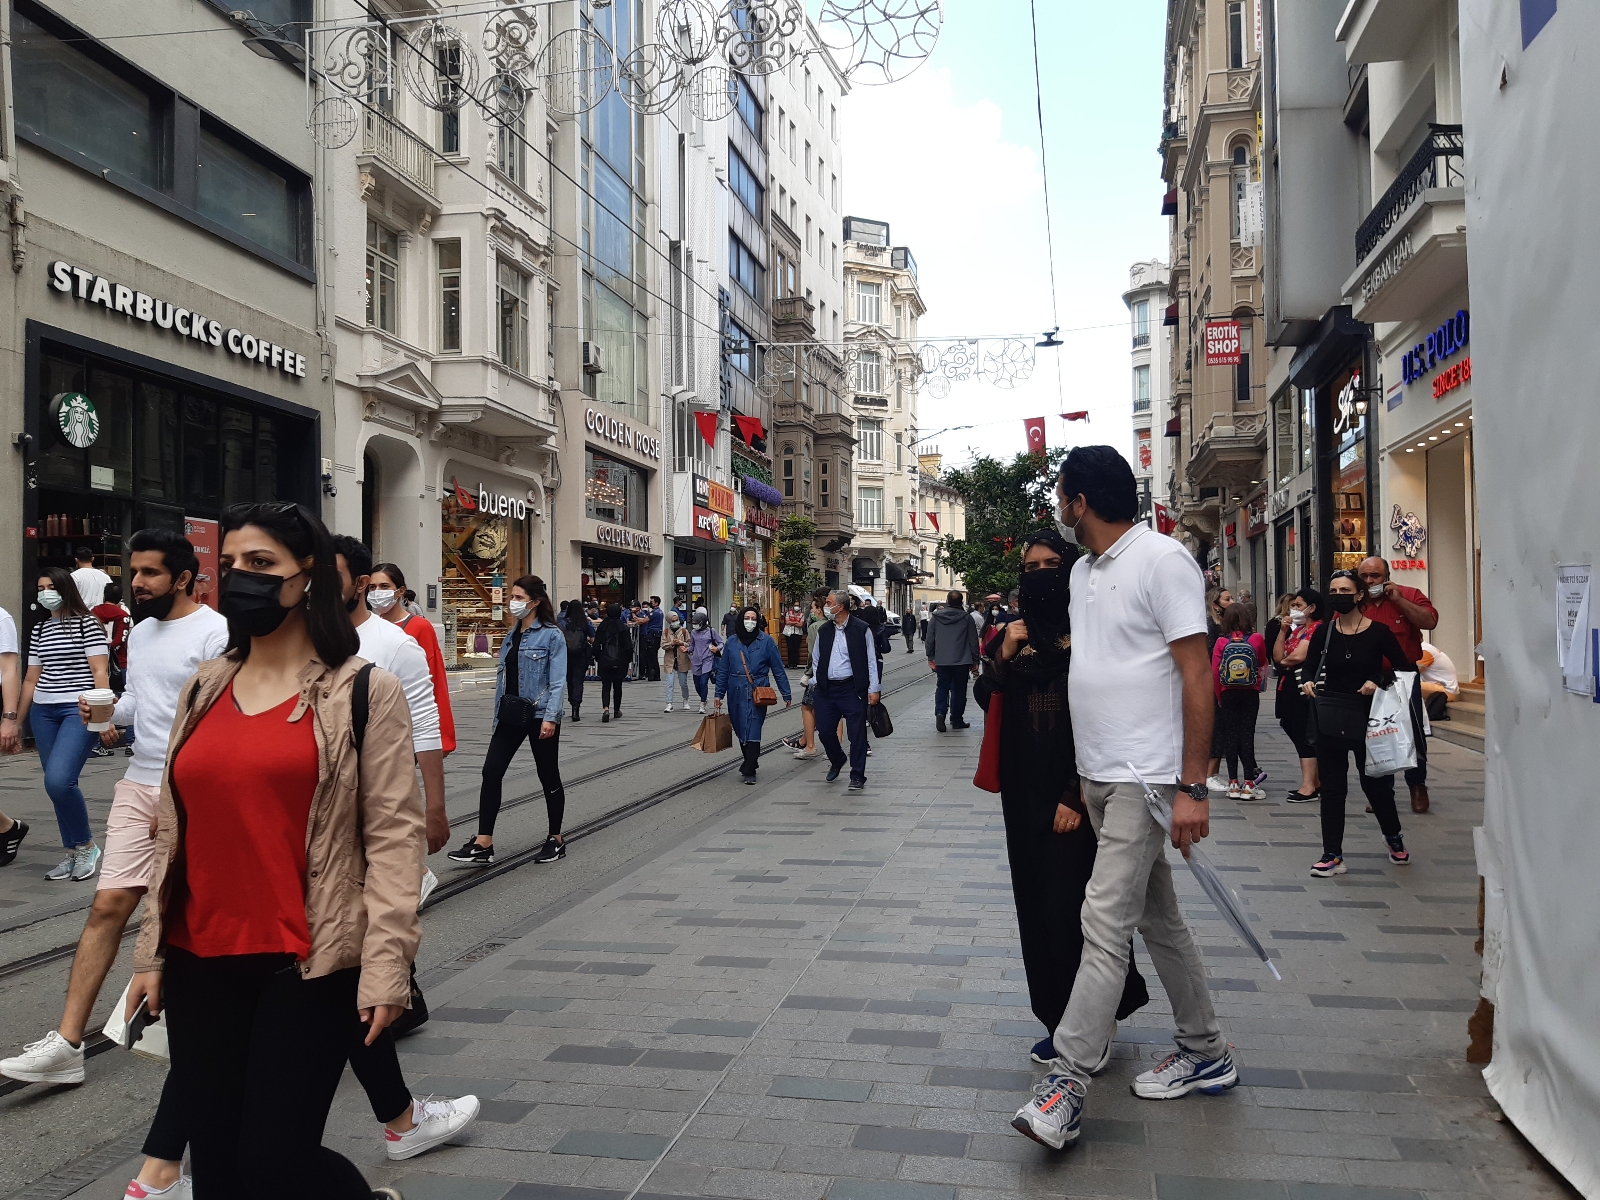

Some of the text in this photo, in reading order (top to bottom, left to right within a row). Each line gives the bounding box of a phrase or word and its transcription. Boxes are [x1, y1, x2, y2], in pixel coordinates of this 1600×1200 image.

[1393, 233, 1414, 275] HAN
[48, 260, 306, 378] STARBUCKS COFFEE
[1207, 323, 1238, 340] EROTİK
[1207, 339, 1239, 354] SHOP
[1426, 309, 1470, 369] POLO
[1431, 365, 1459, 398] SINCE
[585, 407, 661, 459] GOLDEN ROSE
[478, 482, 526, 521] bueno
[597, 525, 652, 549] GOLDEN ROSE
[698, 514, 711, 531] KFC
[1391, 559, 1427, 570] USPA
